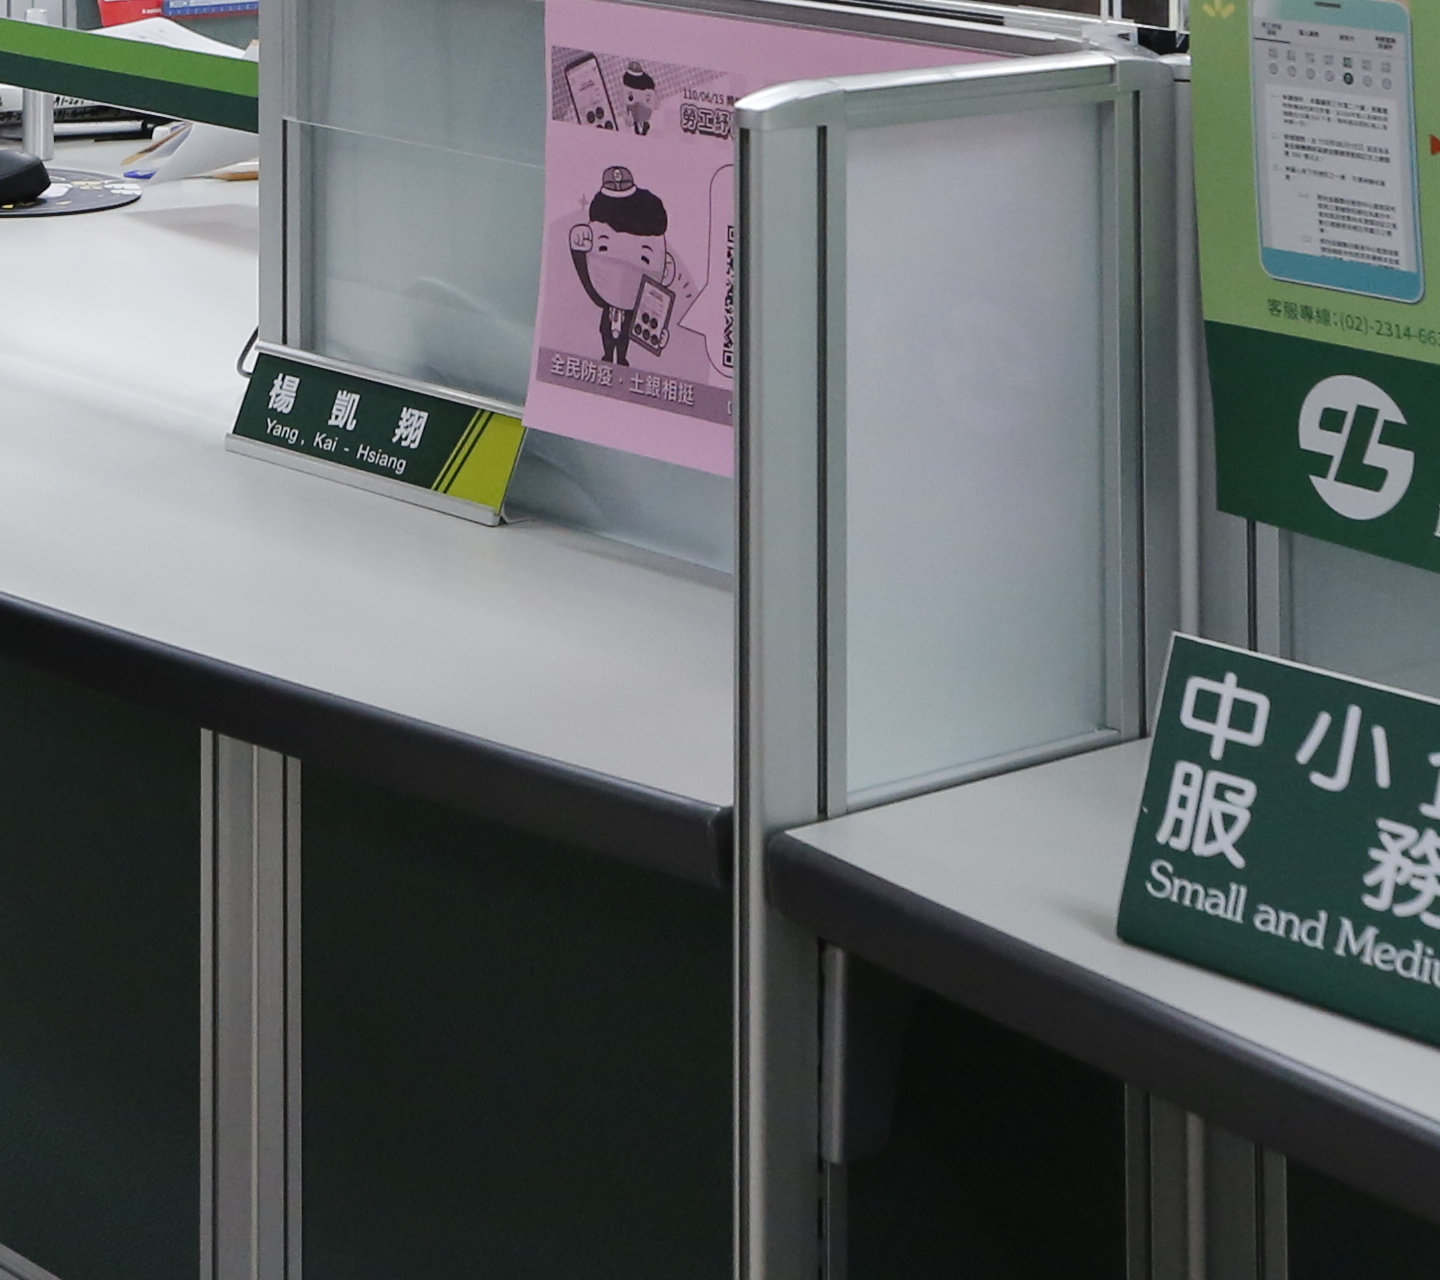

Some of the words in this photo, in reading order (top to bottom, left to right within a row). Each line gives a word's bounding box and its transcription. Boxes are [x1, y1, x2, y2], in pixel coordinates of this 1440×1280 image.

[267, 371, 429, 449] 楊凱翔
[313, 430, 338, 451] Kai
[356, 443, 407, 474] Hsiang
[1144, 860, 1246, 925] Small
[1253, 886, 1326, 950] and
